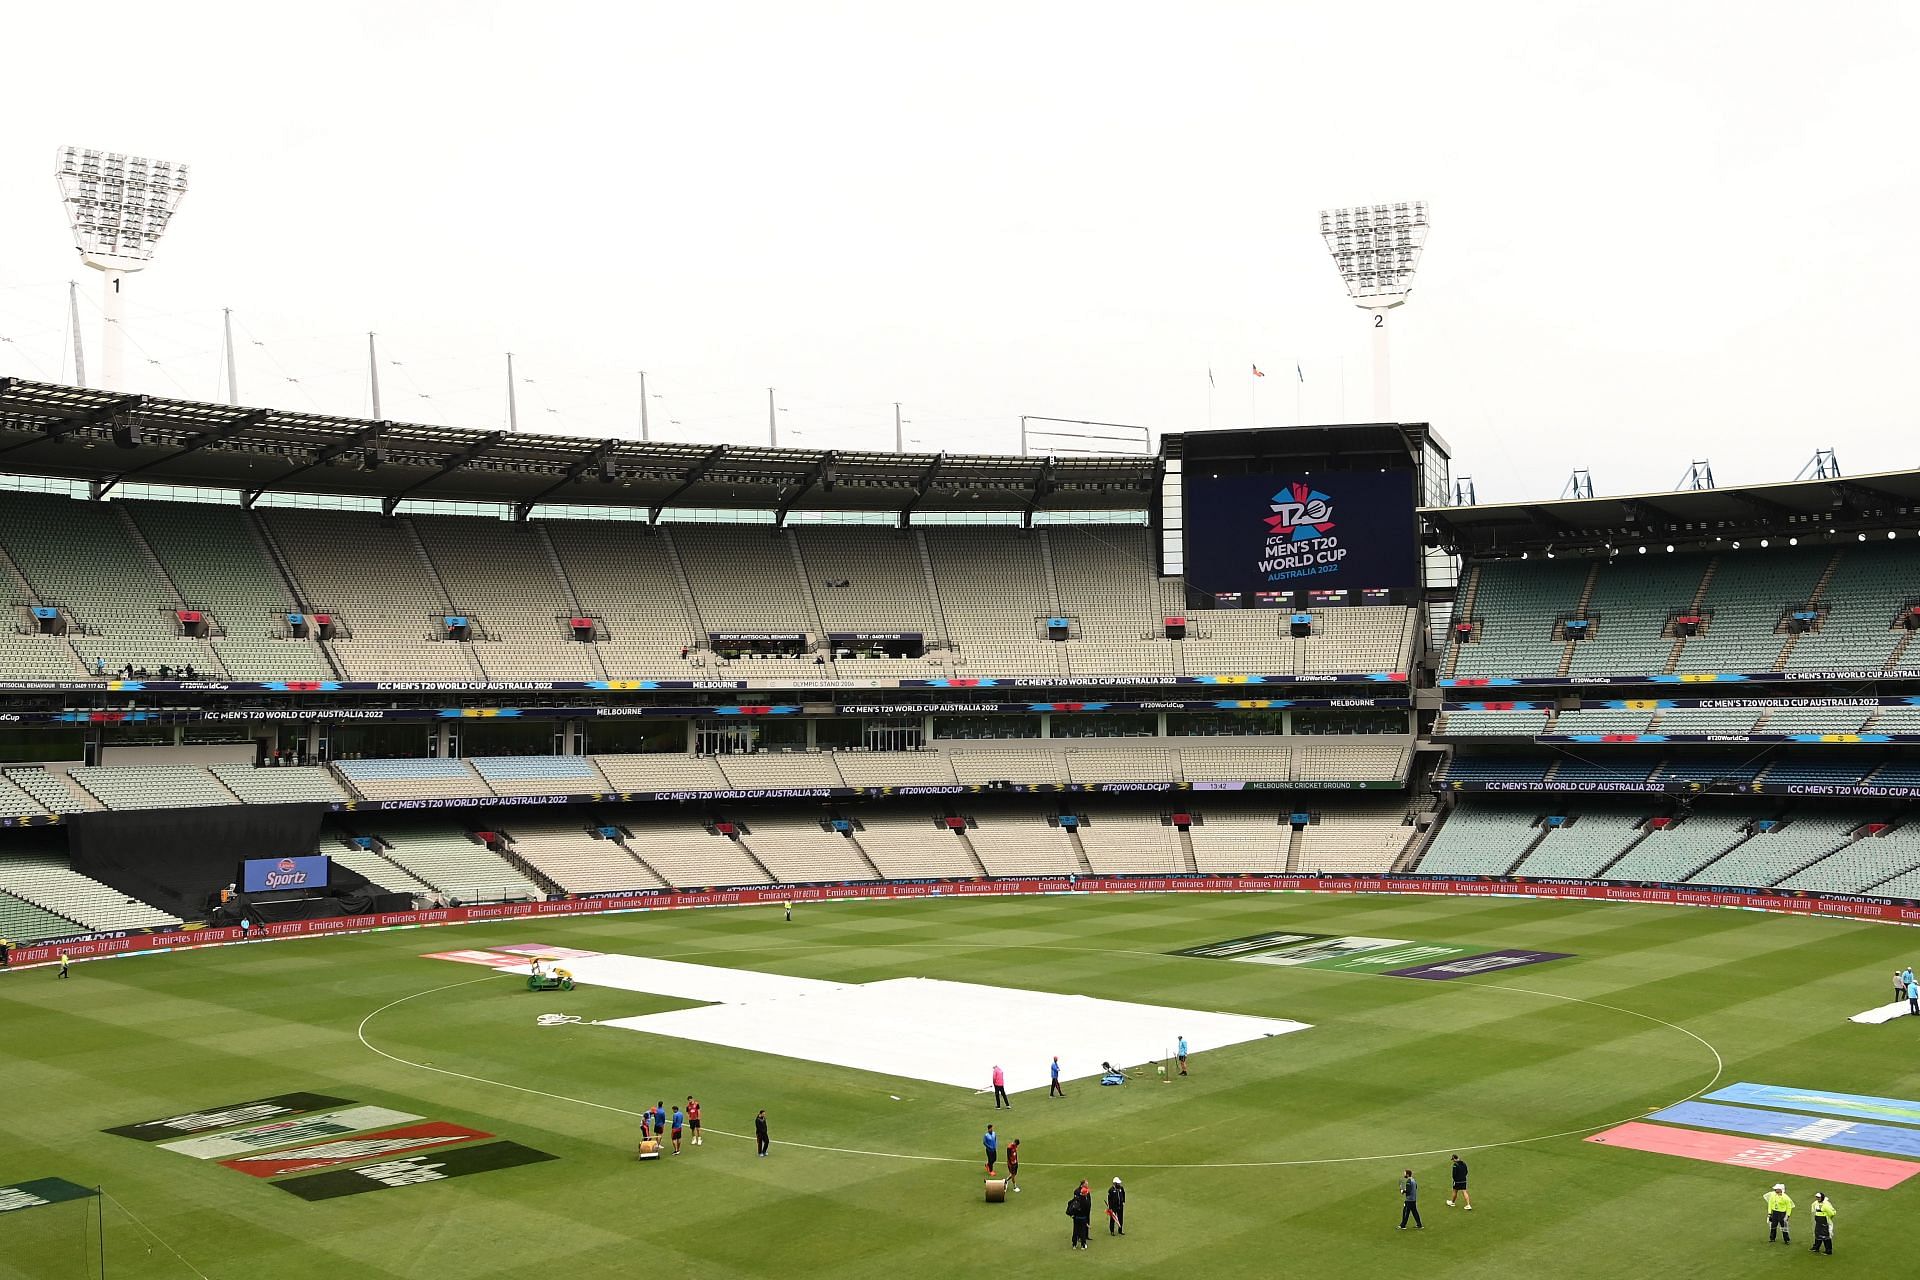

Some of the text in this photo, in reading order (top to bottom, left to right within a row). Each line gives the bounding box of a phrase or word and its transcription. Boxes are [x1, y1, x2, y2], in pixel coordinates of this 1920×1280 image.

[113, 278, 120, 293] 1
[1374, 315, 1383, 328] 2
[1266, 535, 1284, 545] ICC
[1265, 536, 1338, 558] MEN'S T20
[1258, 549, 1347, 573] WORLD CUP
[1267, 564, 1339, 582] AUSTRALIA 2022
[900, 787, 963, 795] #T20WORLDCUP
[1788, 785, 1804, 793] ICC
[1835, 786, 1851, 794] T20
[1852, 787, 1887, 795] WORLD
[1889, 788, 1908, 796] CUP
[381, 801, 398, 809] ICC
[399, 800, 426, 808] MEN'S
[499, 796, 547, 805] AUSTRALIA
[266, 871, 306, 889] Sportz
[1607, 889, 1640, 898] Emirates
[584, 901, 602, 909] BETTER
[1747, 898, 1781, 907] Emirates
[1793, 900, 1811, 909] BETTER
[1818, 902, 1882, 915] Emirates FLY BETTER
[309, 917, 375, 930] Emirates FLY BETTER
[382, 911, 447, 923] Emirates FLY BETTER
[153, 931, 224, 945] Emirates FLY BETTER
[98, 942, 108, 952] FLY
[109, 940, 130, 951] BETTER
